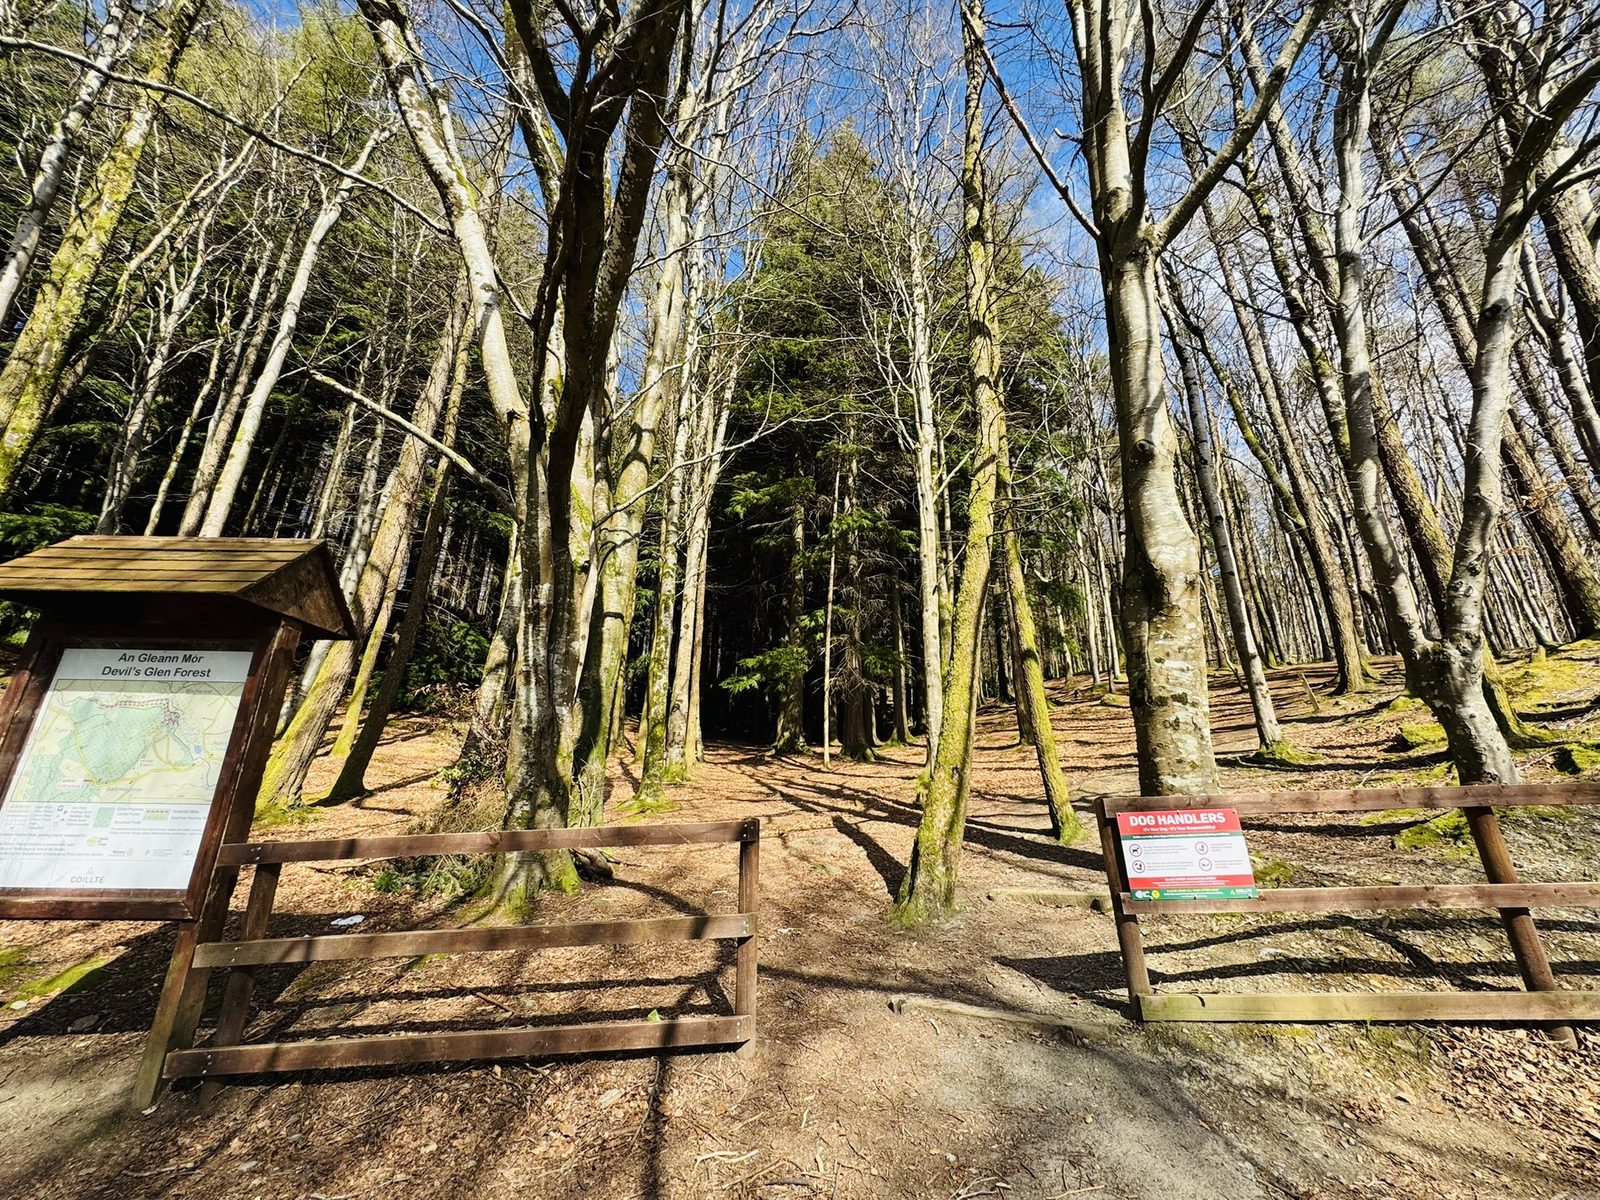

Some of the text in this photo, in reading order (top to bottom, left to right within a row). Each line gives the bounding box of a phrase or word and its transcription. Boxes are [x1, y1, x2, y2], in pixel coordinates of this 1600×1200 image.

[118, 653, 135, 663] An
[138, 653, 179, 663] Gleann
[101, 666, 211, 678] Devil's Glen Forest
[1128, 812, 1226, 826] DOG HANDLERS
[70, 875, 105, 884] COILLTE
